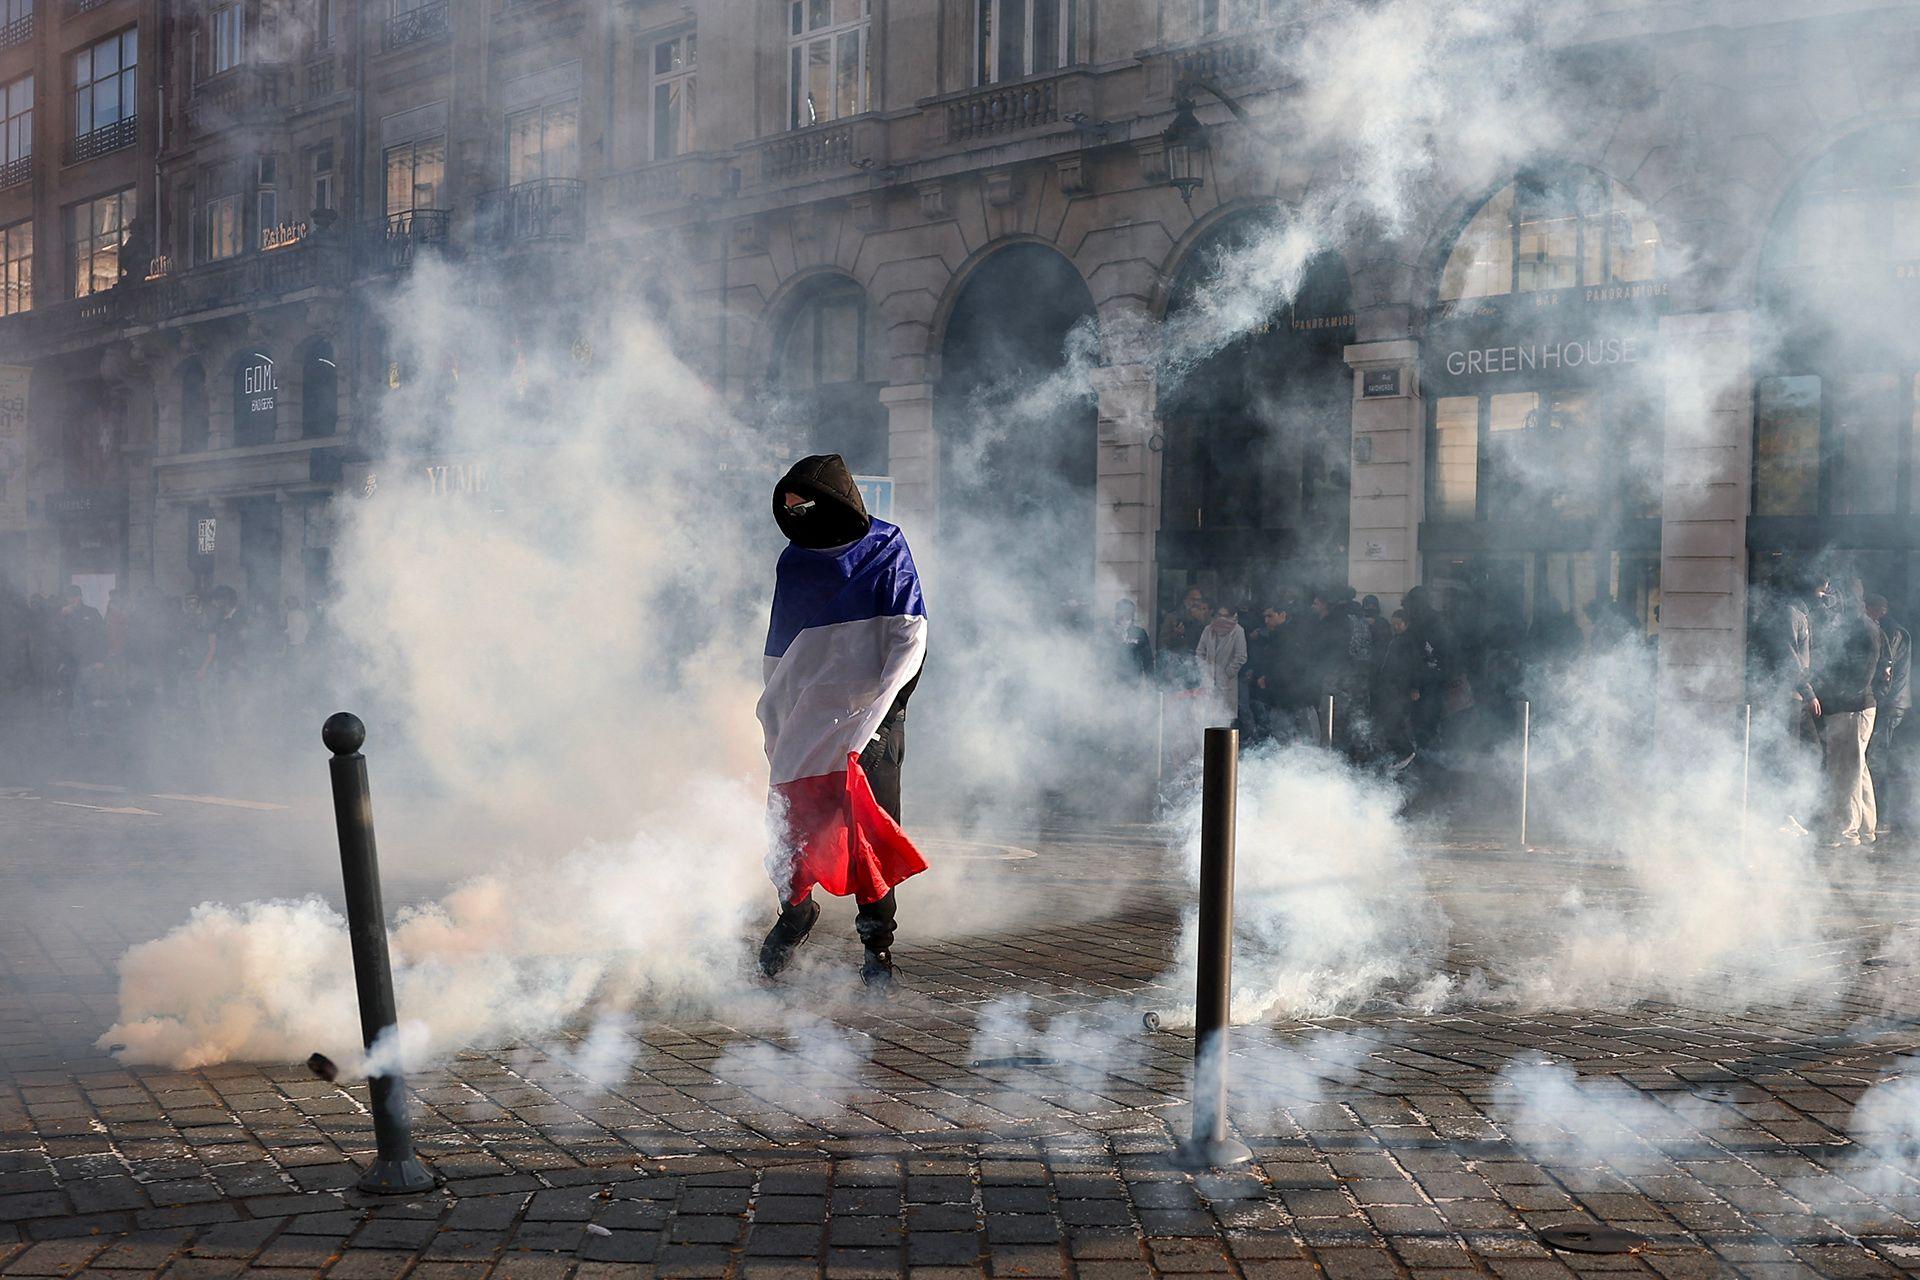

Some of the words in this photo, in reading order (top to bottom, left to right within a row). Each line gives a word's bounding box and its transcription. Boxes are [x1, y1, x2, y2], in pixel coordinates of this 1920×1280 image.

[1895, 264, 1920, 280] BA
[1446, 345, 1536, 375] GREEN
[1542, 338, 1637, 369] HOUSE
